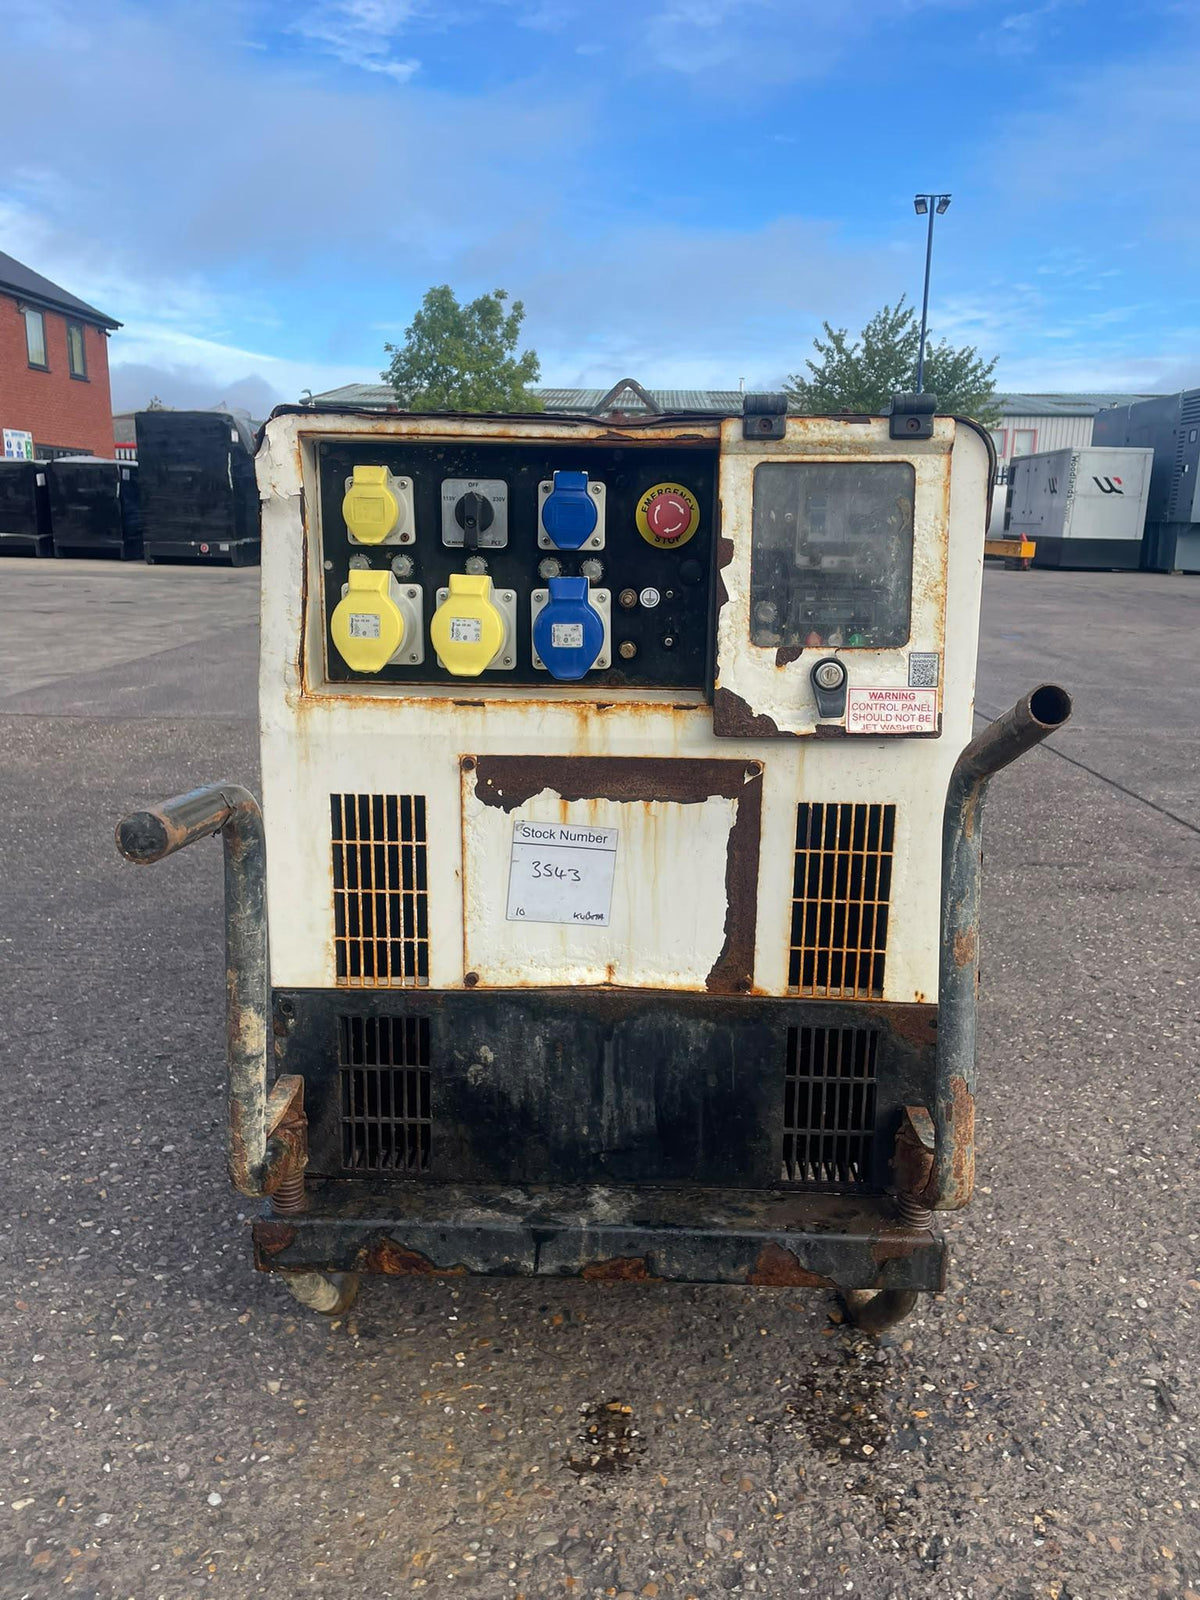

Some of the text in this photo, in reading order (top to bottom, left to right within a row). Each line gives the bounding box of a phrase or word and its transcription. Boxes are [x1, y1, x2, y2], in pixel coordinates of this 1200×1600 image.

[641, 487, 695, 513] EMERGENCY
[868, 692, 916, 700] WARNING
[851, 702, 933, 712] CONTROL PANEL
[852, 713, 932, 723] SHOULD NOT BE
[522, 827, 608, 844] Stock Number
